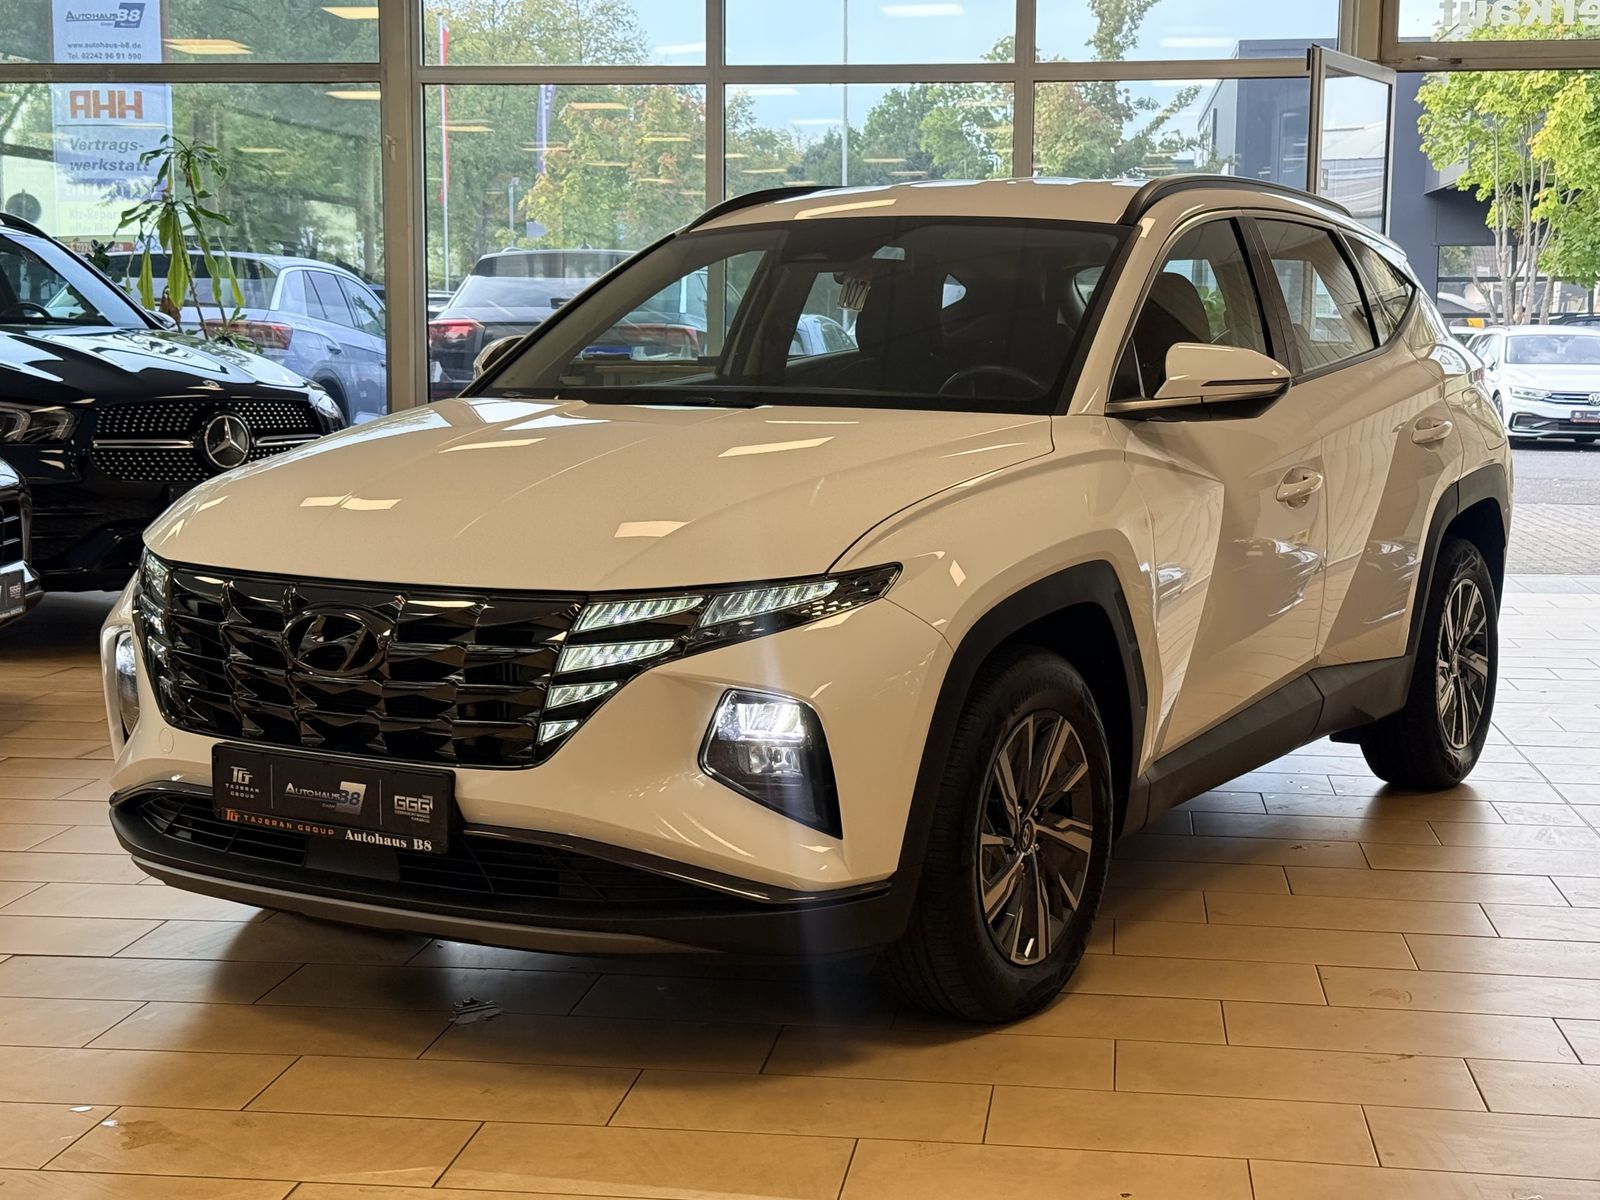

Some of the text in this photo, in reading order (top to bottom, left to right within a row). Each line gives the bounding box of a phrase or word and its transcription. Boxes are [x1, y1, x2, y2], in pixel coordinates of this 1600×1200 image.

[67, 41, 142, 49] www.autohaus-b8.de
[69, 90, 144, 120] AHH
[70, 138, 145, 154] Vertrags-
[70, 158, 150, 172] werkstatt
[230, 790, 255, 799] GROUP
[394, 795, 431, 814] GGG
[243, 815, 292, 829] TAJERAN
[297, 824, 335, 835] GROUP
[345, 829, 432, 852] Autohaus B8
